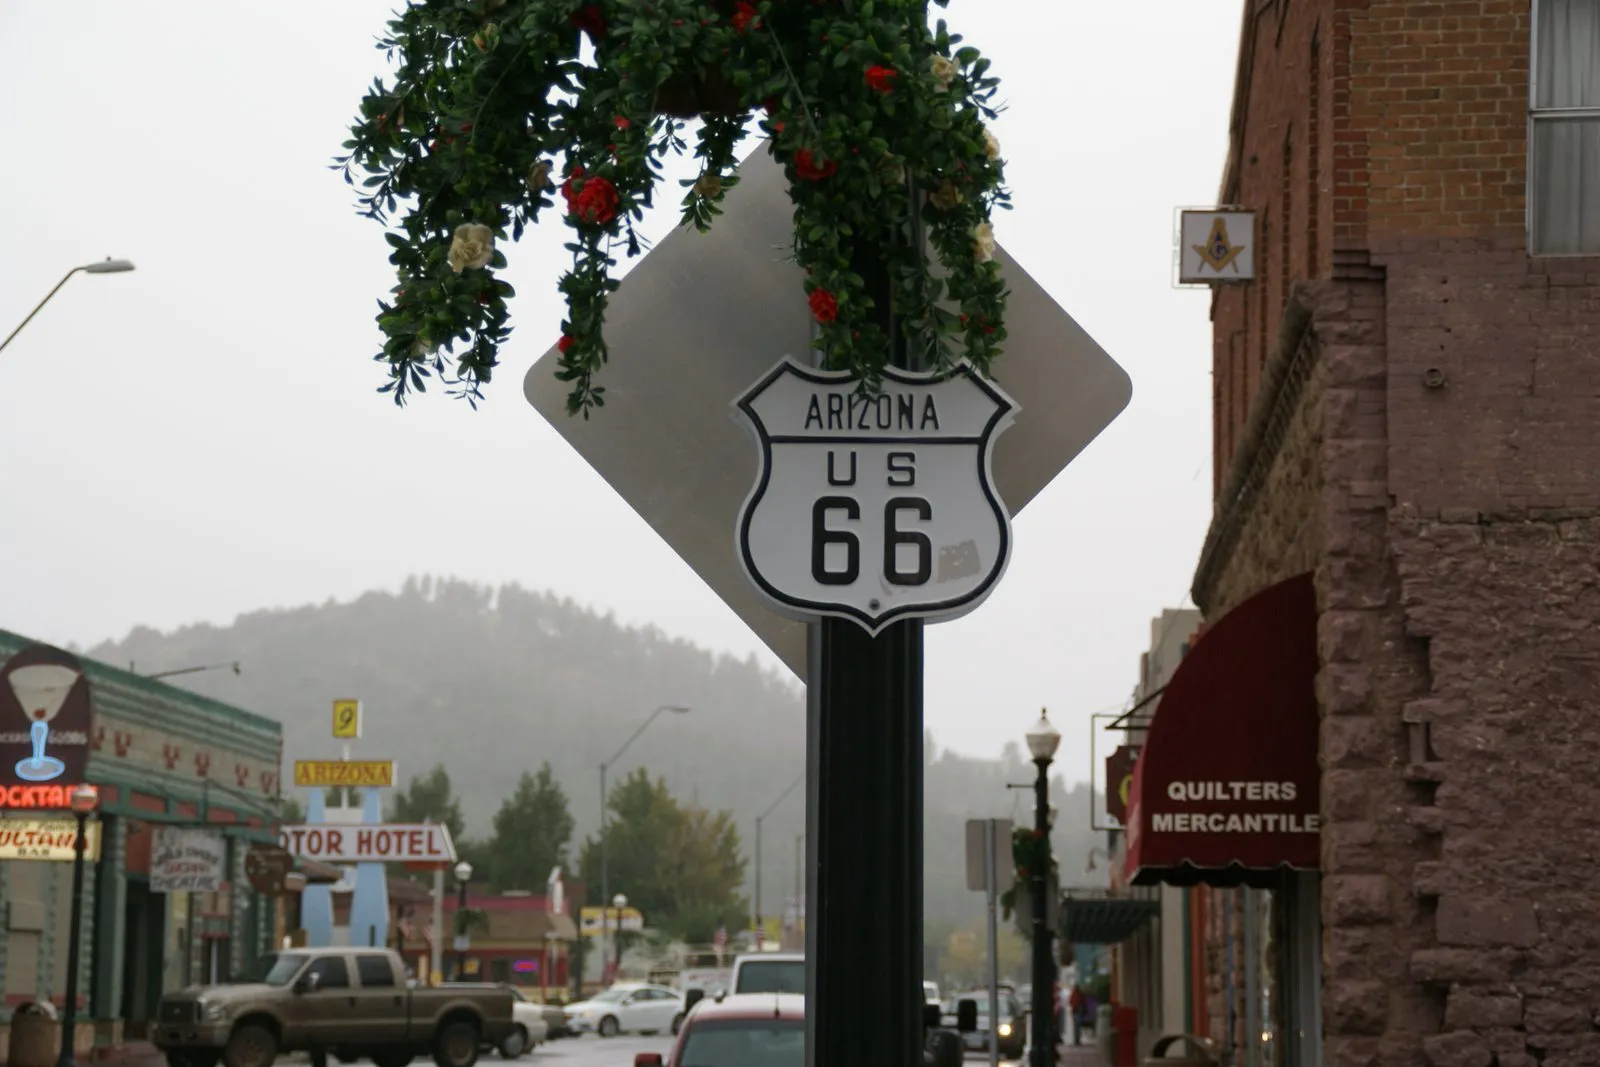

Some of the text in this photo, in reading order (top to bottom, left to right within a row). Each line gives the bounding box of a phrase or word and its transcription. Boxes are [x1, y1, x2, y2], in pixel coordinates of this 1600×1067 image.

[804, 393, 939, 430] ARIZONA
[811, 496, 932, 586] 66
[300, 764, 390, 782] ARIZONA
[1167, 781, 1297, 802] QUILTERS
[1152, 813, 1320, 833] MERCANTILE
[355, 829, 442, 856] HOTEL
